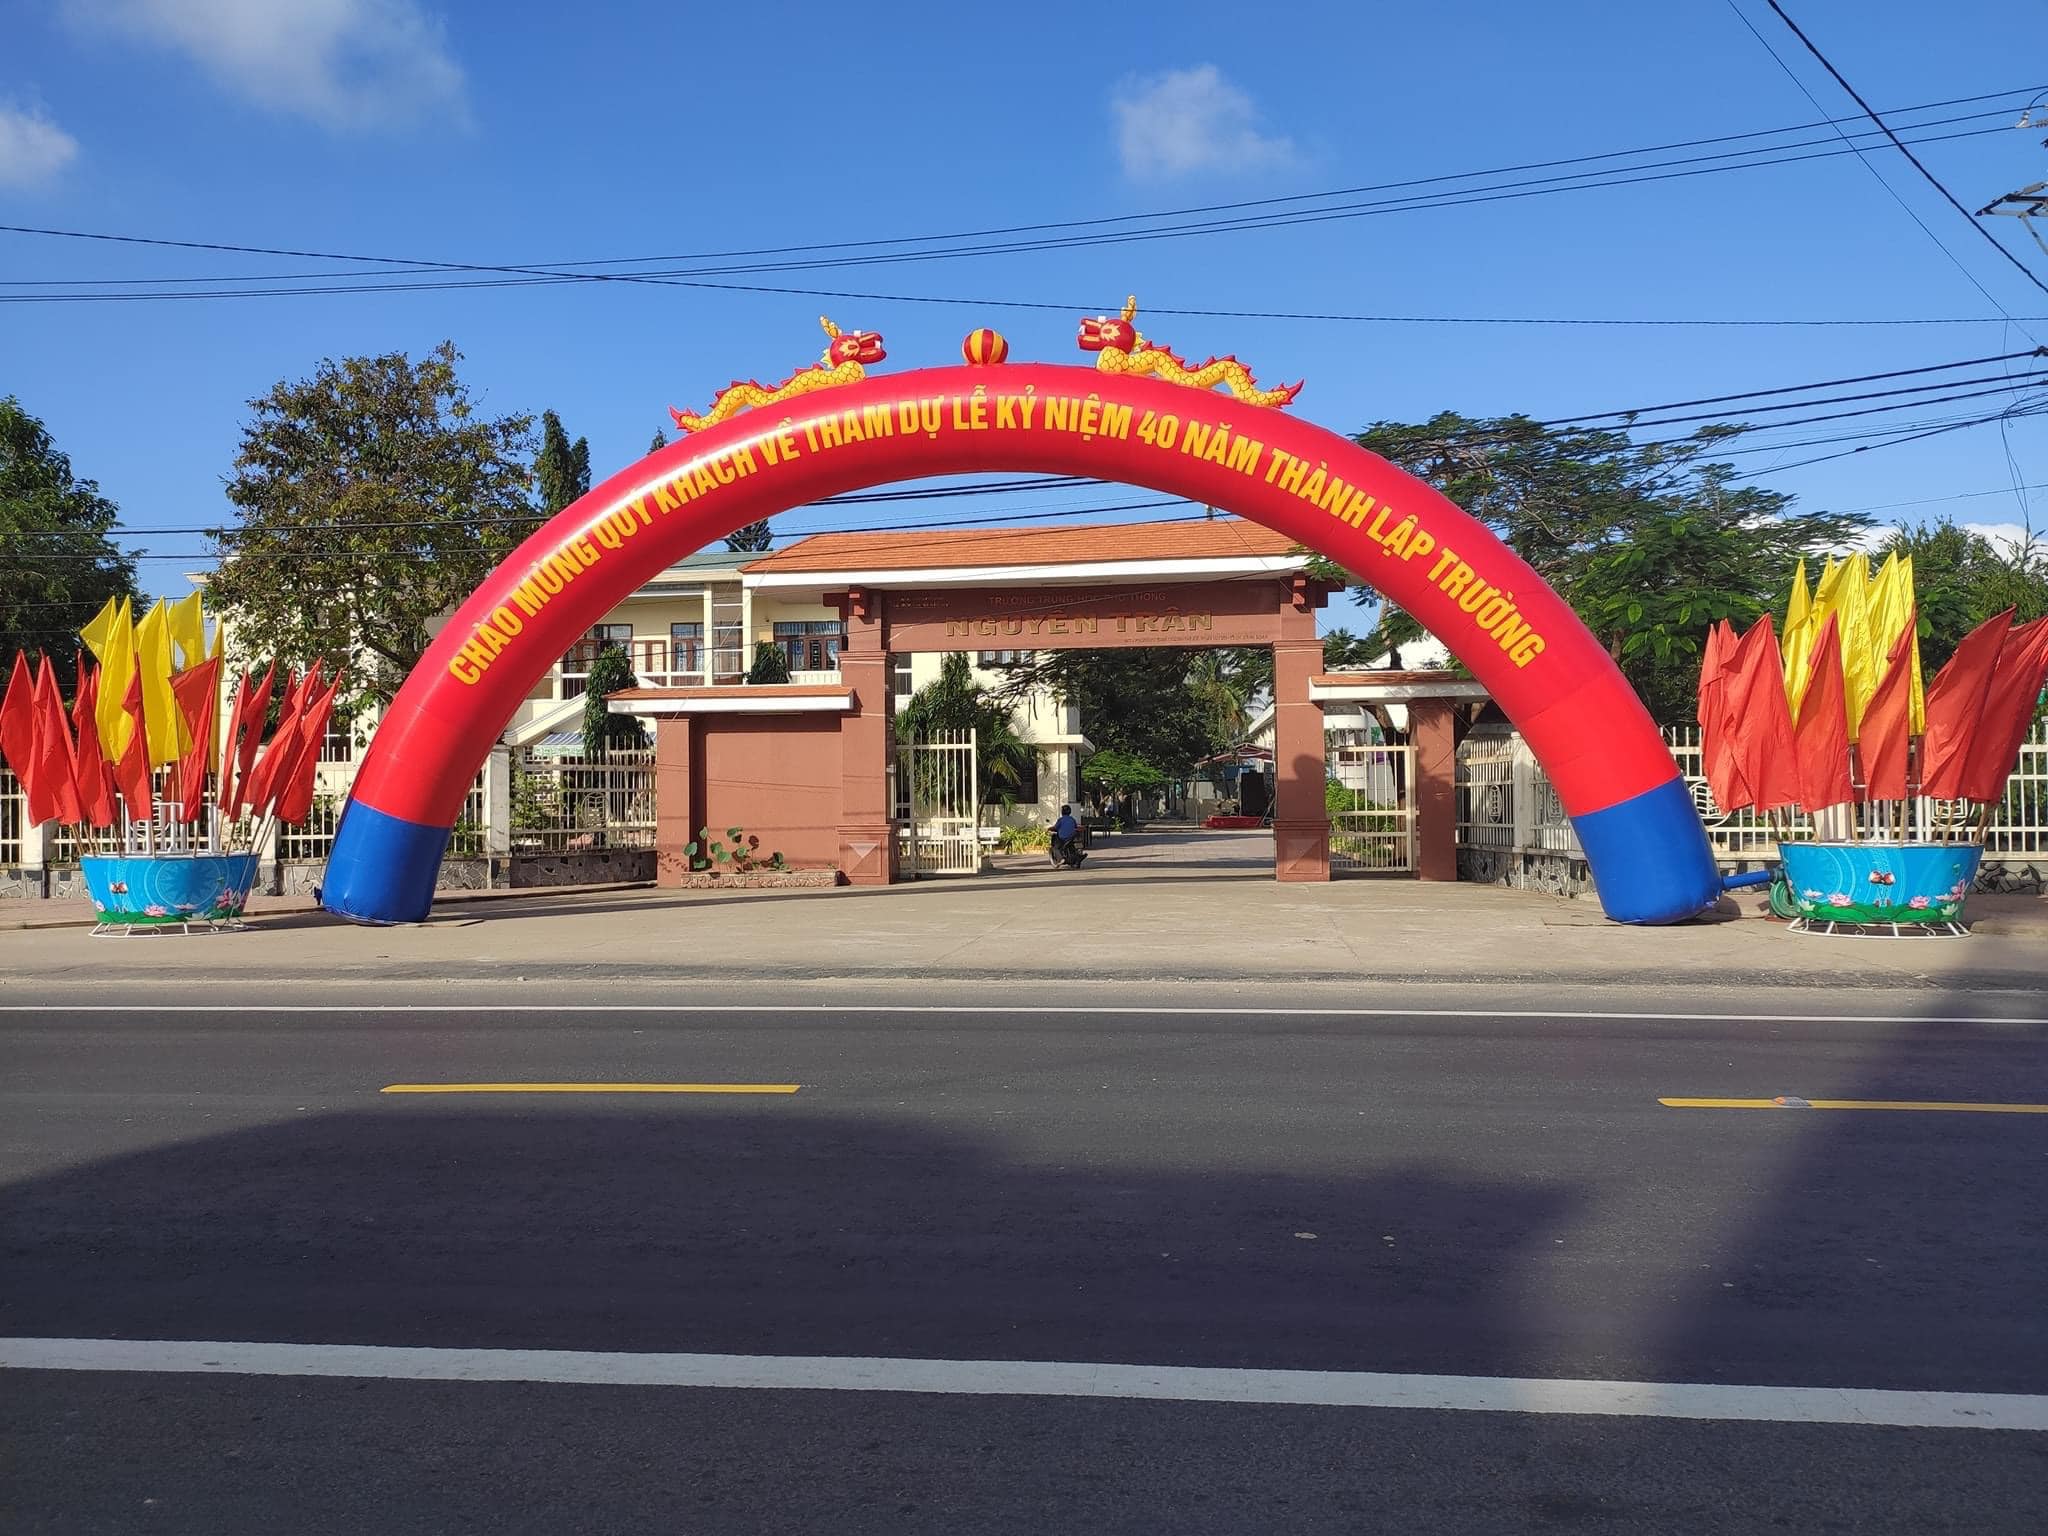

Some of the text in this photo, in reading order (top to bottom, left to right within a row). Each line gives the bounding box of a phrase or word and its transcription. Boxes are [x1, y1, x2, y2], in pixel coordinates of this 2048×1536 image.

[447, 384, 1547, 686] CHÀO MỪNG QUÝ KHÁCH VỀ THAM DỰ LỄ KỶ NIỆM 40 NĂM THÀNH LẬP TRƯỜNG
